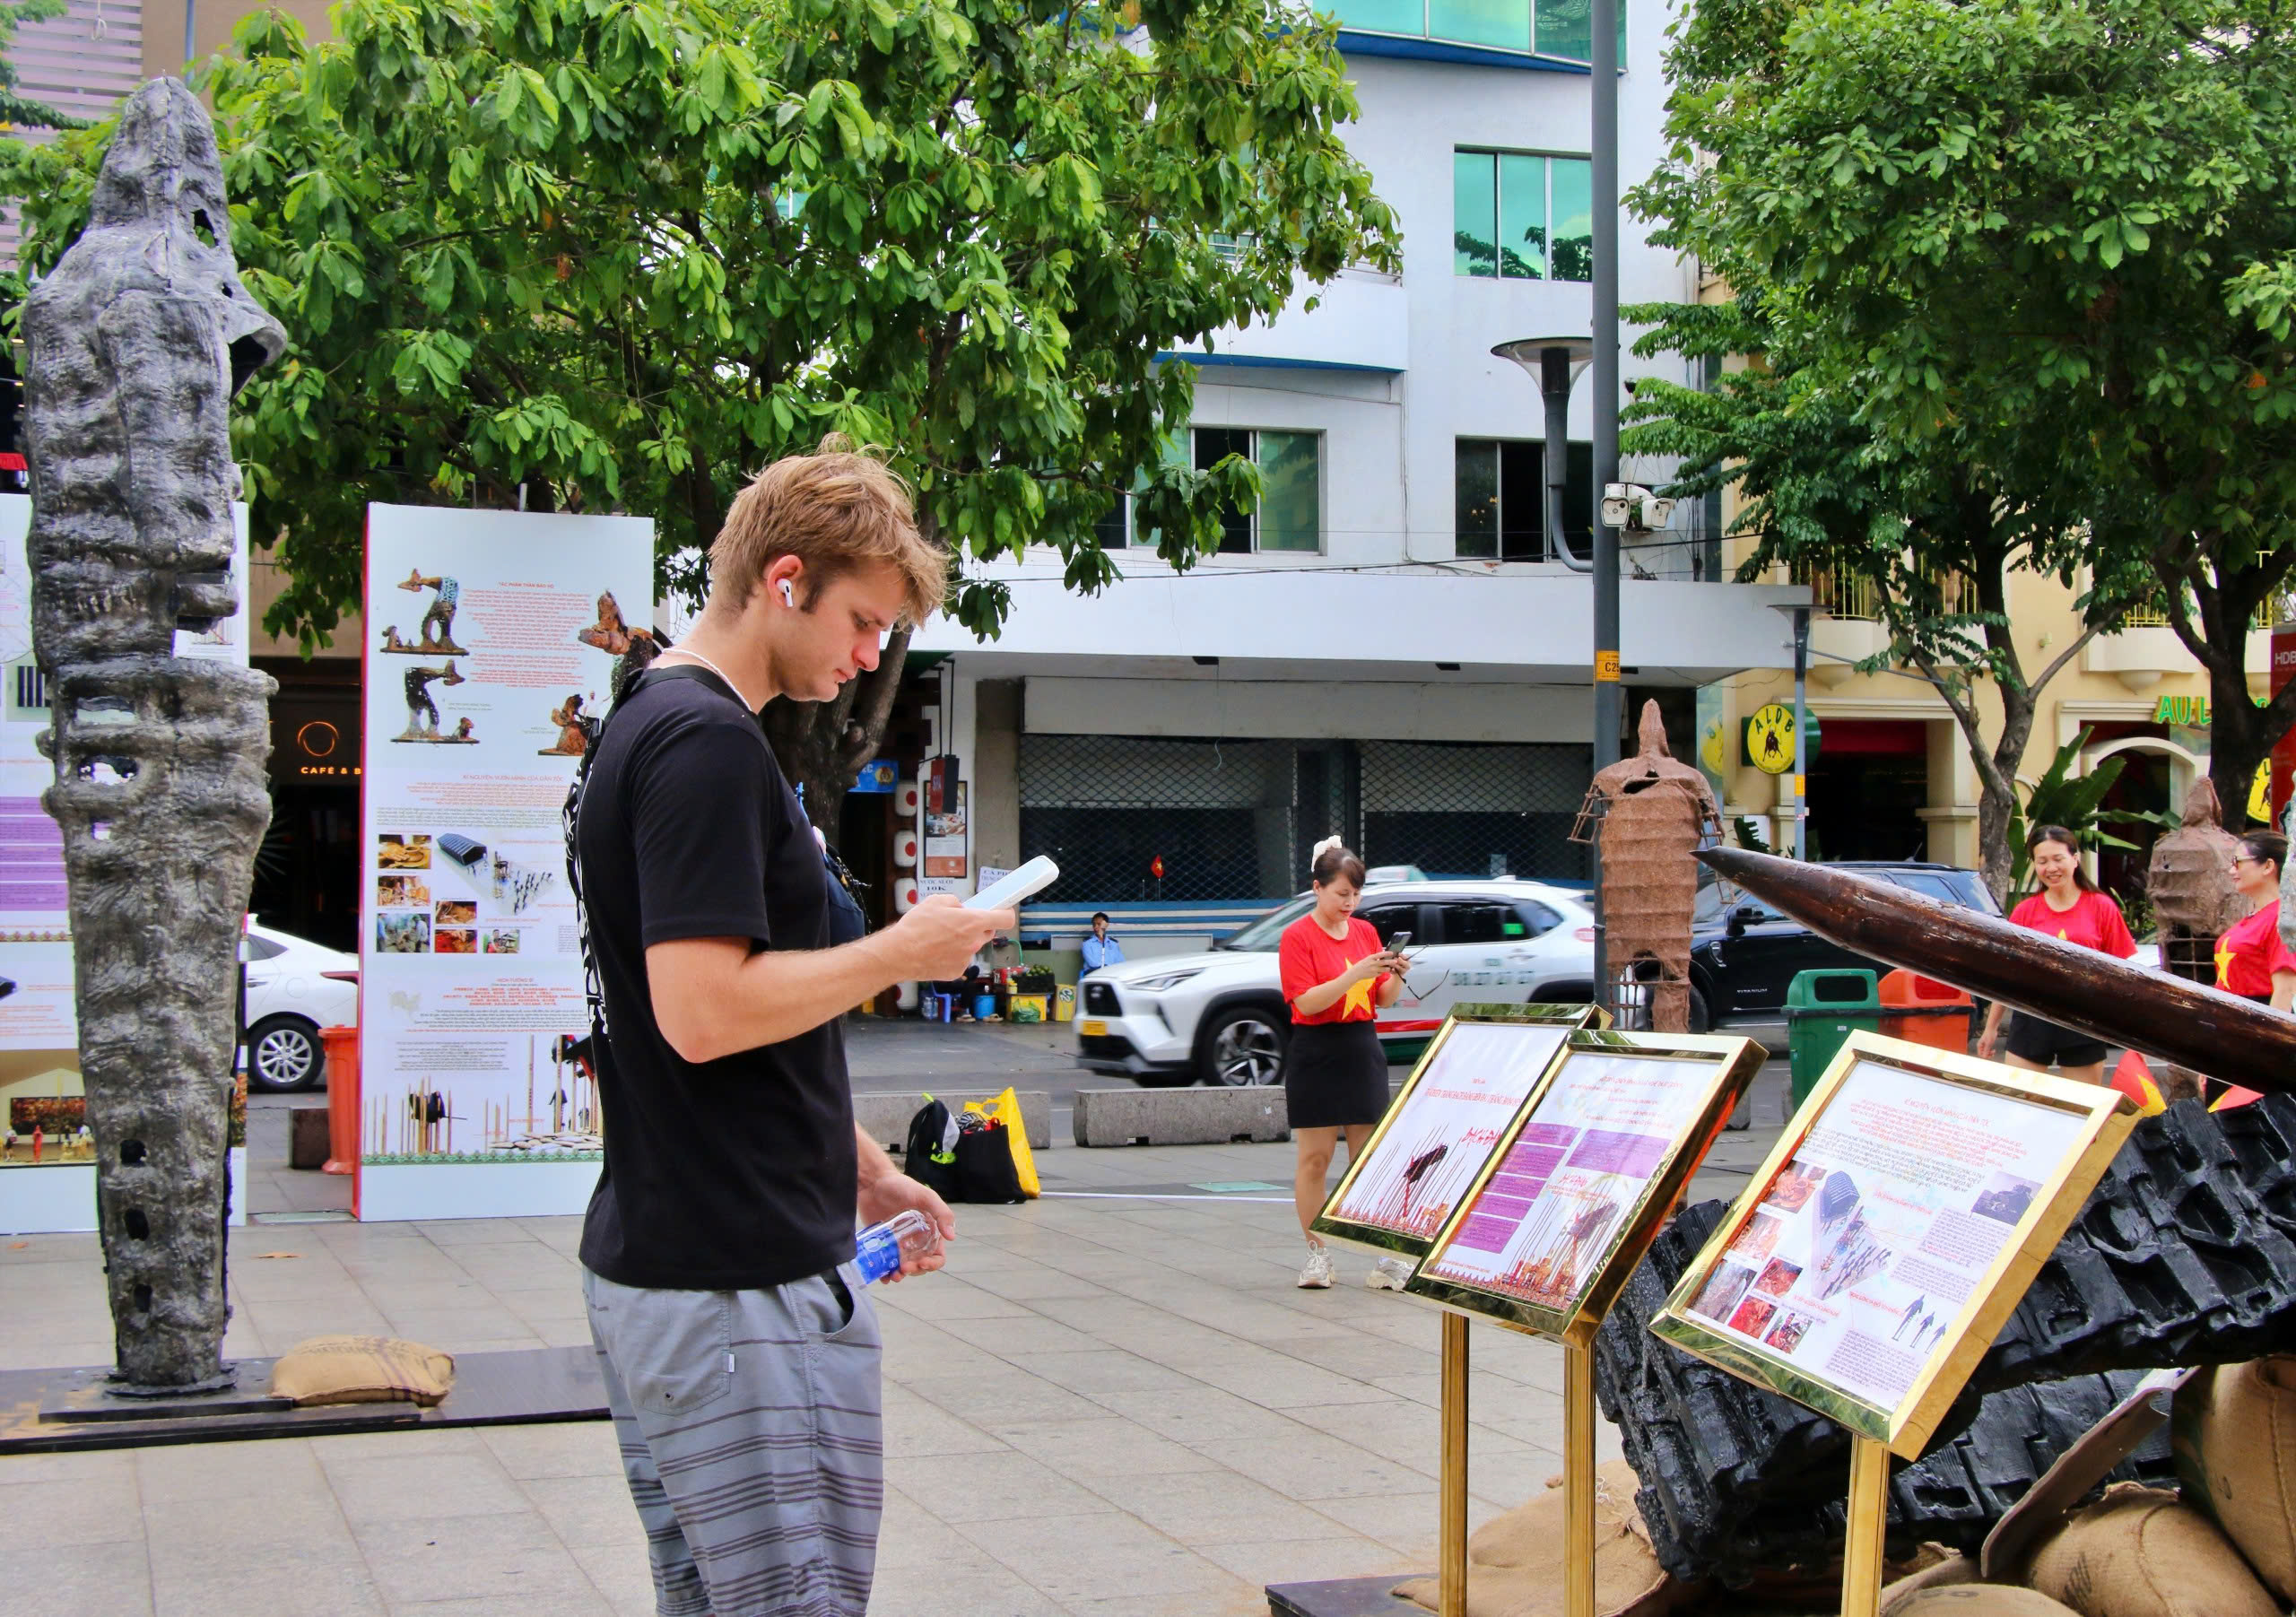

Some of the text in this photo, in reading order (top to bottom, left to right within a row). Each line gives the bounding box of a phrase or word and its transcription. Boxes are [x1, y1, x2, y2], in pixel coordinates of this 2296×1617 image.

[1754, 708, 1794, 735] ALDB
[300, 766, 335, 774] CAFÉ
[341, 767, 348, 775] &
